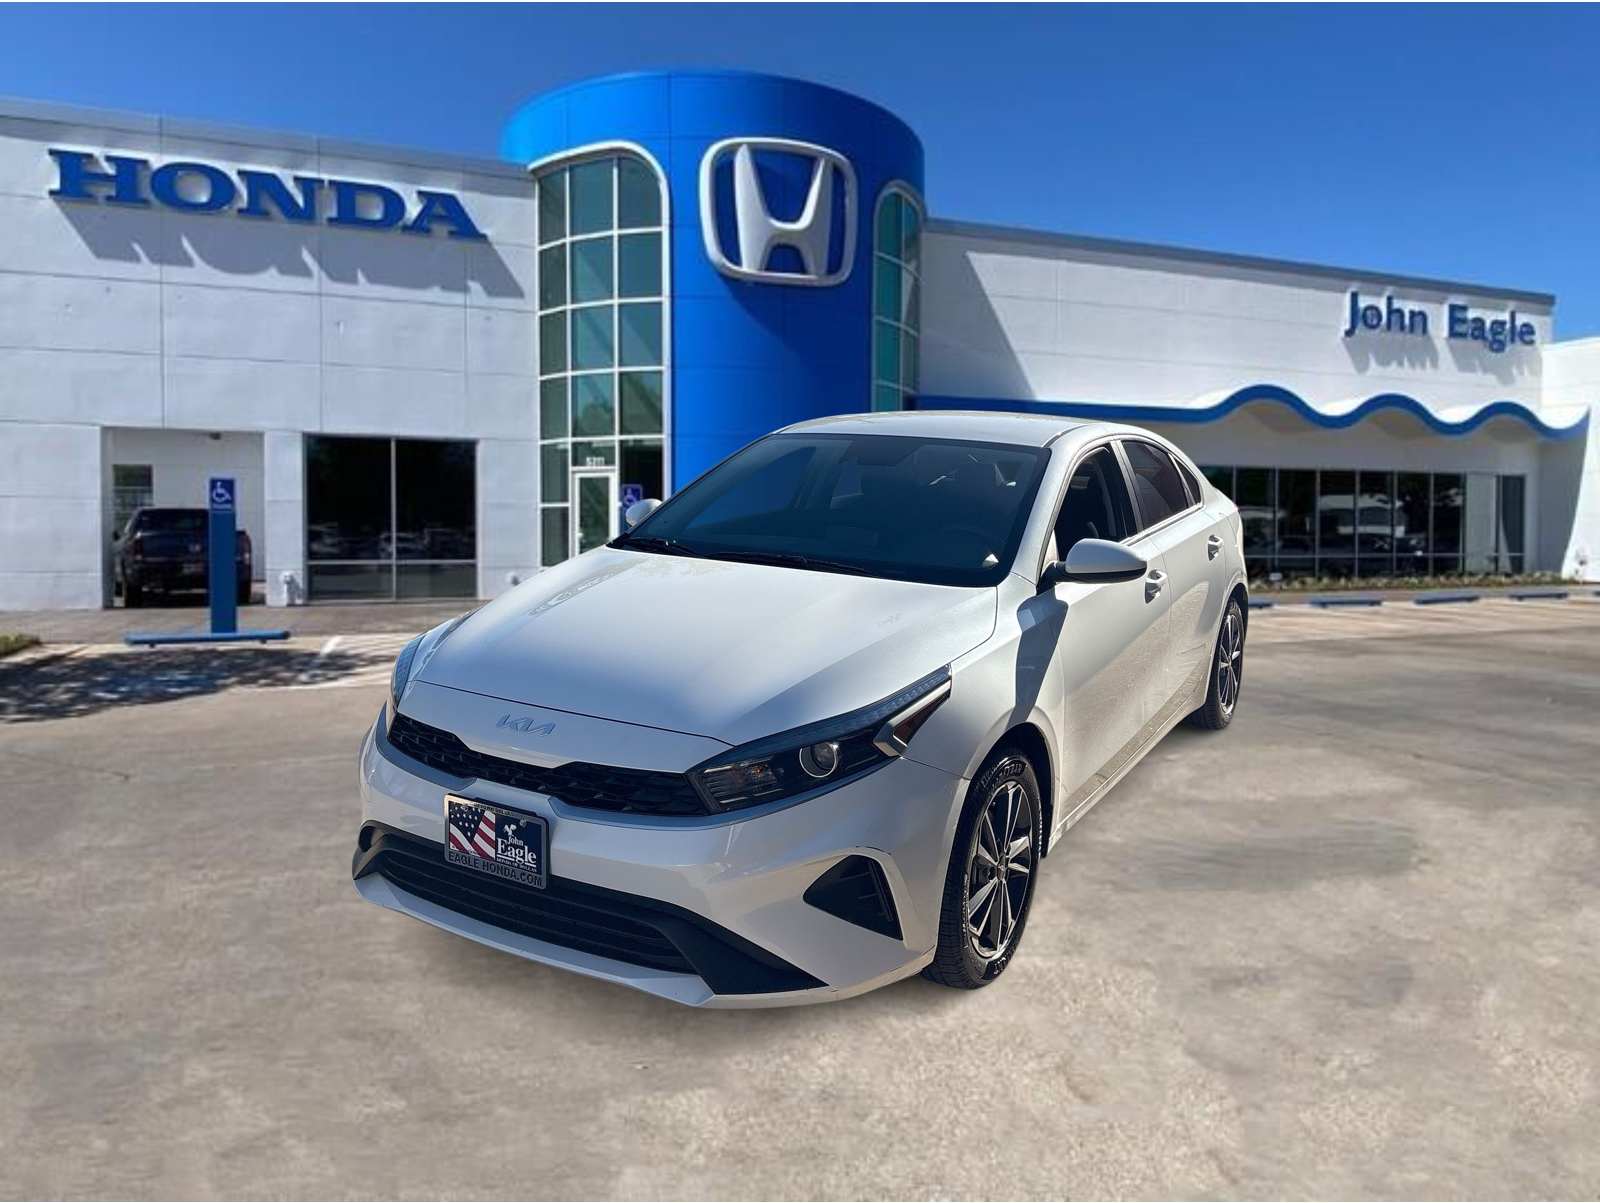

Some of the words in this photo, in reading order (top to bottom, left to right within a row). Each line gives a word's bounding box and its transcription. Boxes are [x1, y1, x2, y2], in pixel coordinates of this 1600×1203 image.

[48, 148, 487, 240] HONDA
[1344, 291, 1428, 338] John
[1448, 303, 1536, 353] Eagle
[496, 837, 537, 864] Eagle
[507, 834, 524, 846] John
